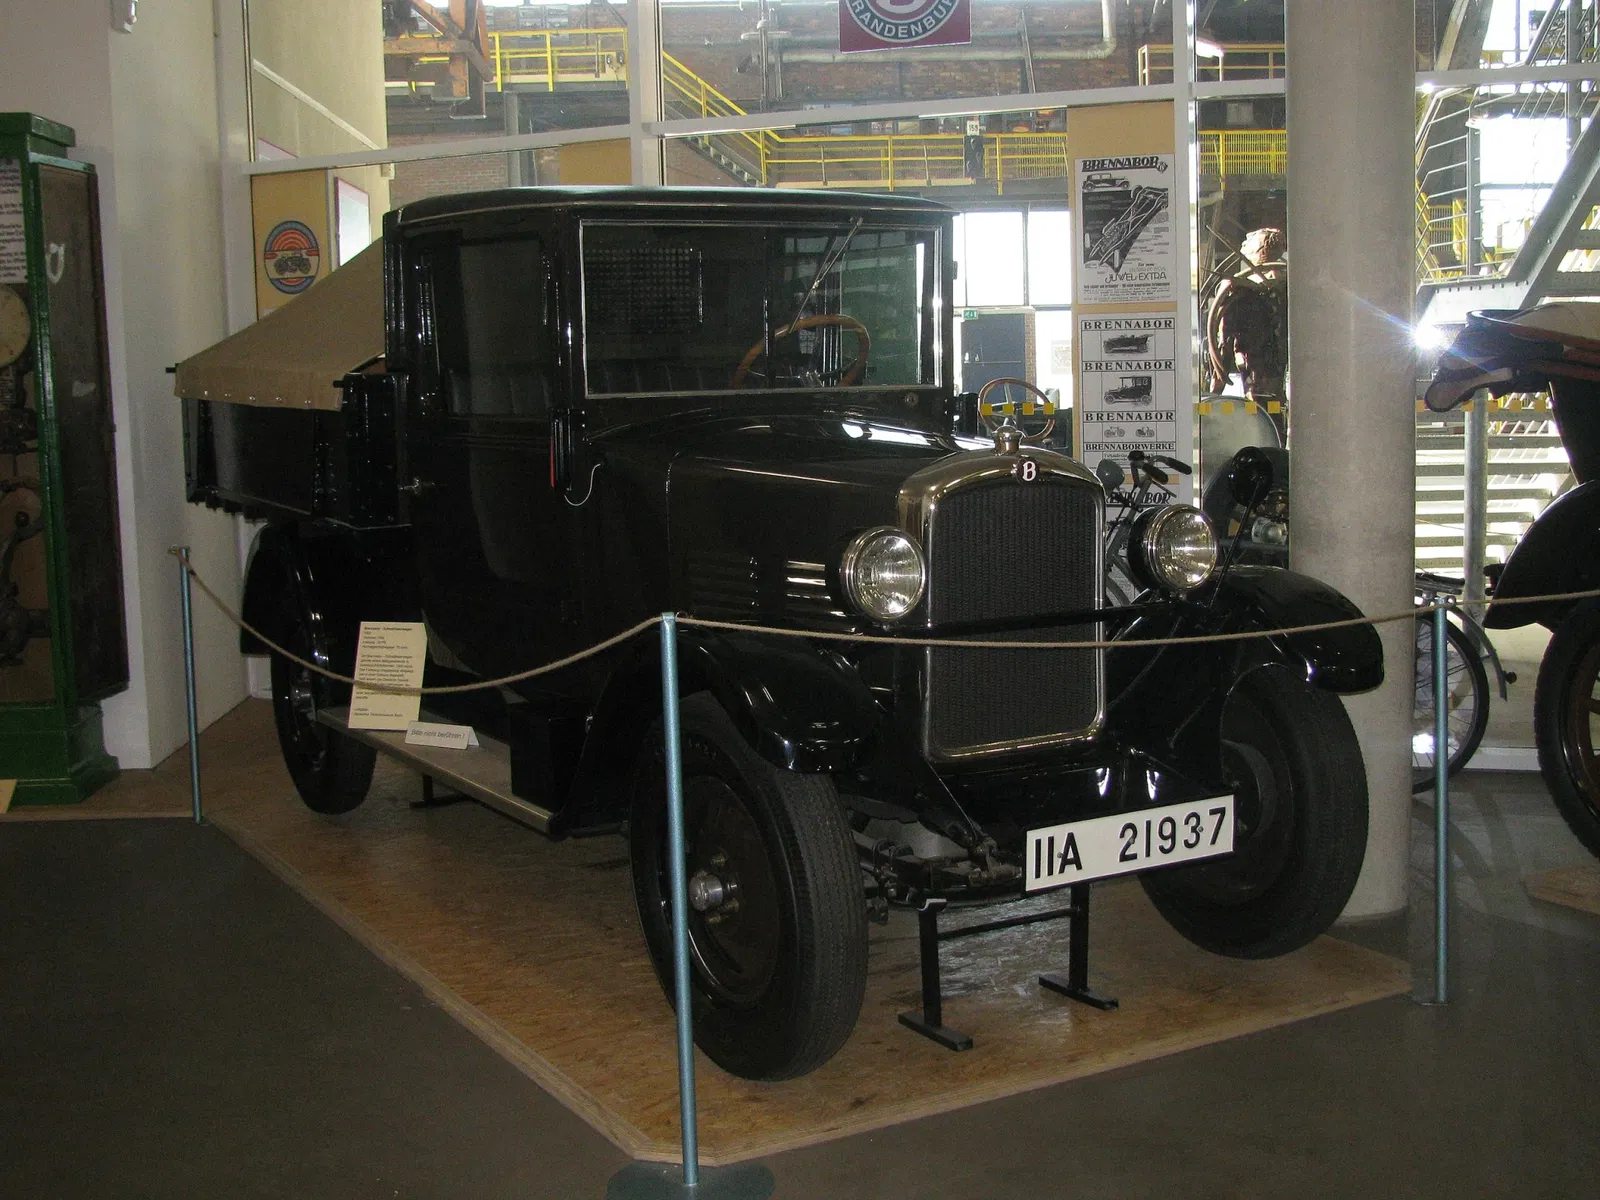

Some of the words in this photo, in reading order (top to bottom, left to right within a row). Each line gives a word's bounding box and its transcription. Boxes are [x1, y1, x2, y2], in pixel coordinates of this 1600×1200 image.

[1083, 319, 1172, 330] BRENNABOR
[1084, 360, 1173, 371] BRENNABOR
[1085, 411, 1174, 421] BRENNABOR
[1085, 443, 1175, 451] BRENNABORWERKE
[1022, 460, 1036, 481] B
[1034, 831, 1083, 880] IIA
[1118, 806, 1226, 863] 21937
